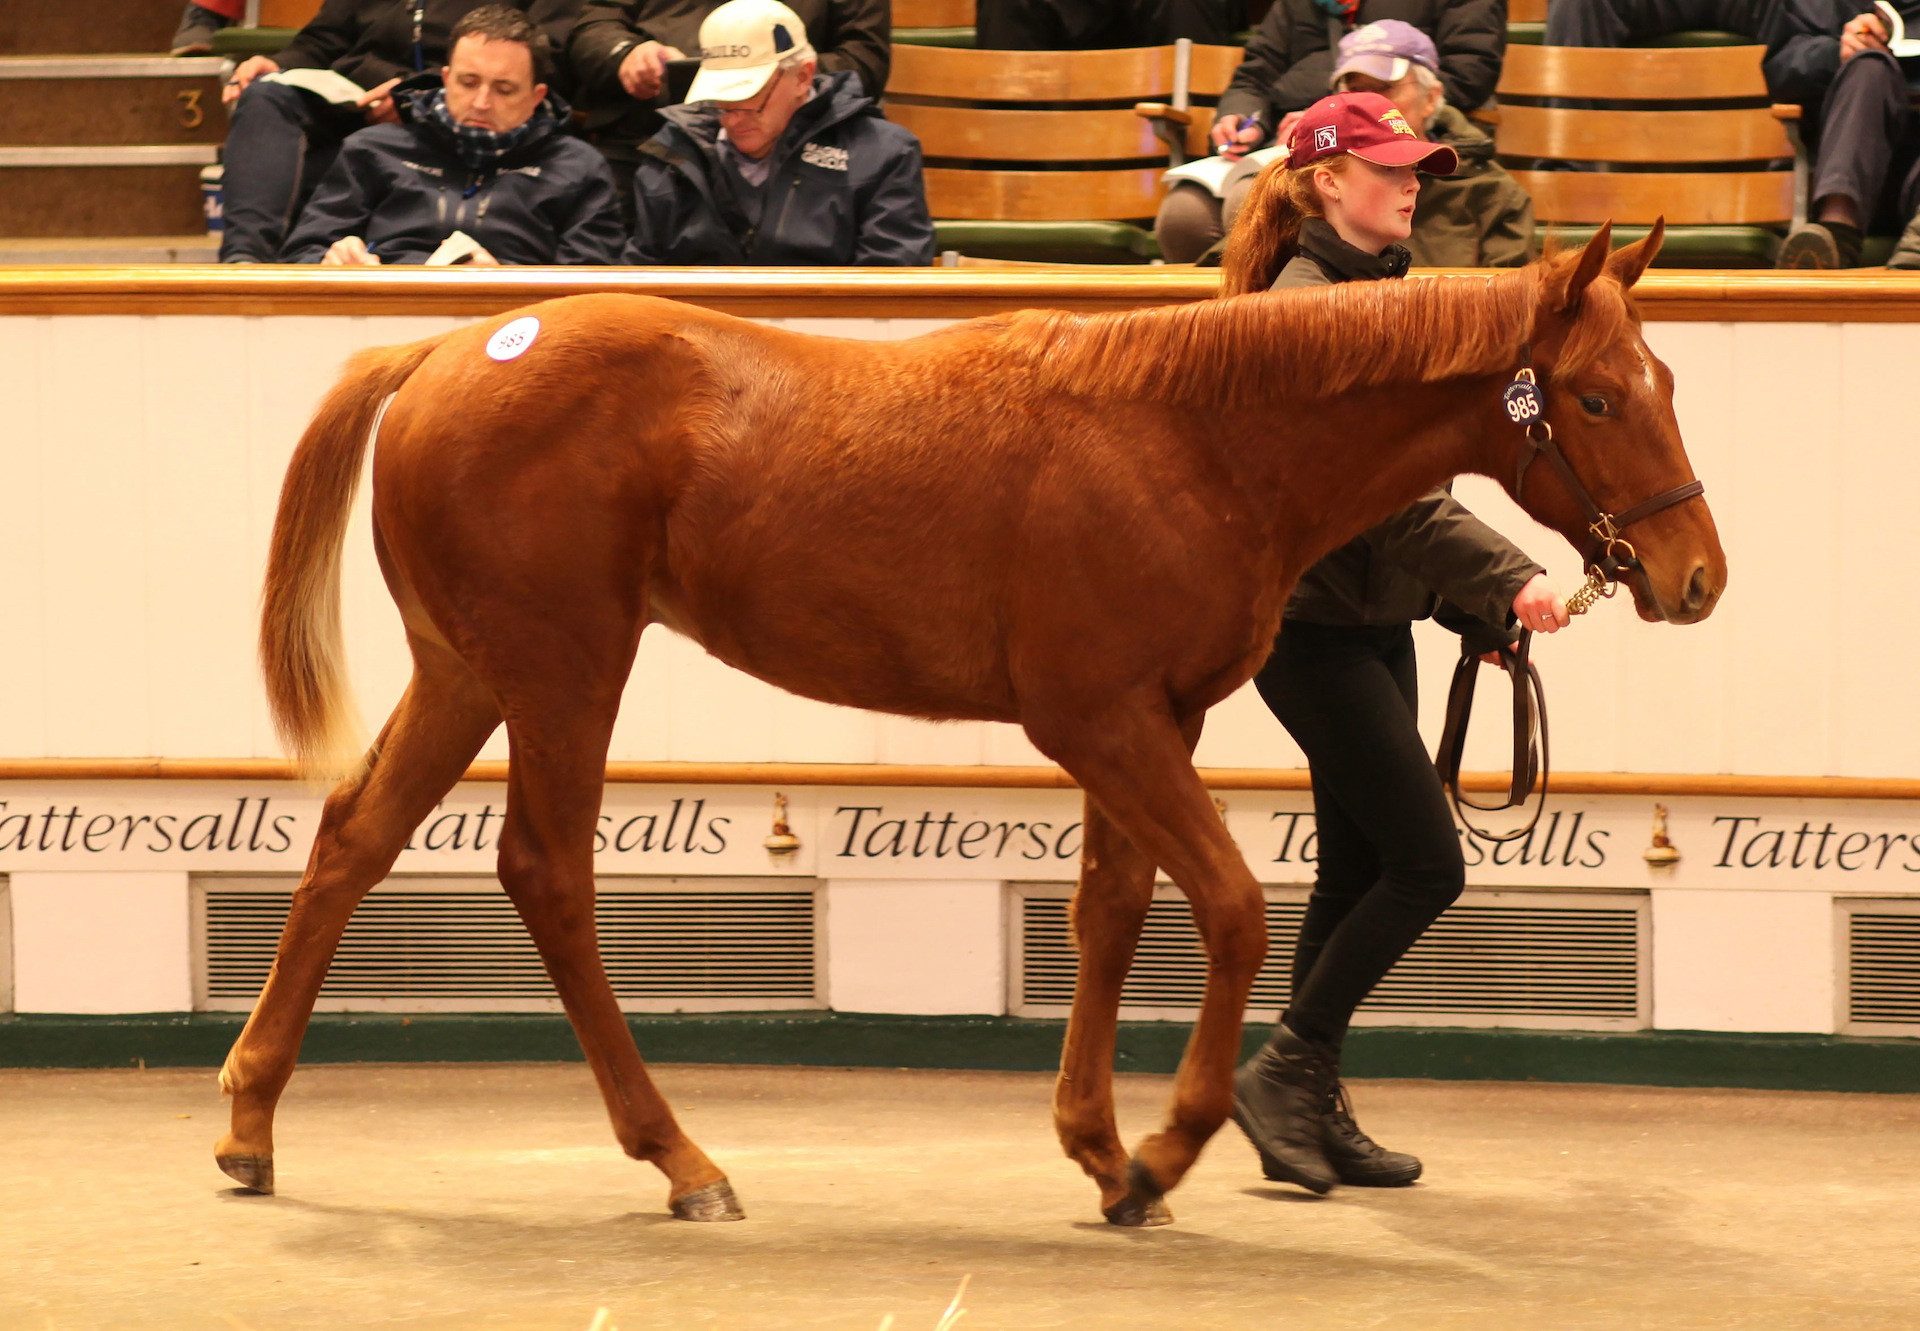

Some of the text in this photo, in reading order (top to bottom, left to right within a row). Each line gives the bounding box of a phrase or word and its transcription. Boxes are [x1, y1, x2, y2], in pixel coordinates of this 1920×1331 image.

[177, 90, 204, 129] 3
[1507, 393, 1539, 422] 985
[0, 797, 296, 853] attersalls
[403, 798, 731, 855] atsalls
[835, 806, 1083, 860] Tattersa
